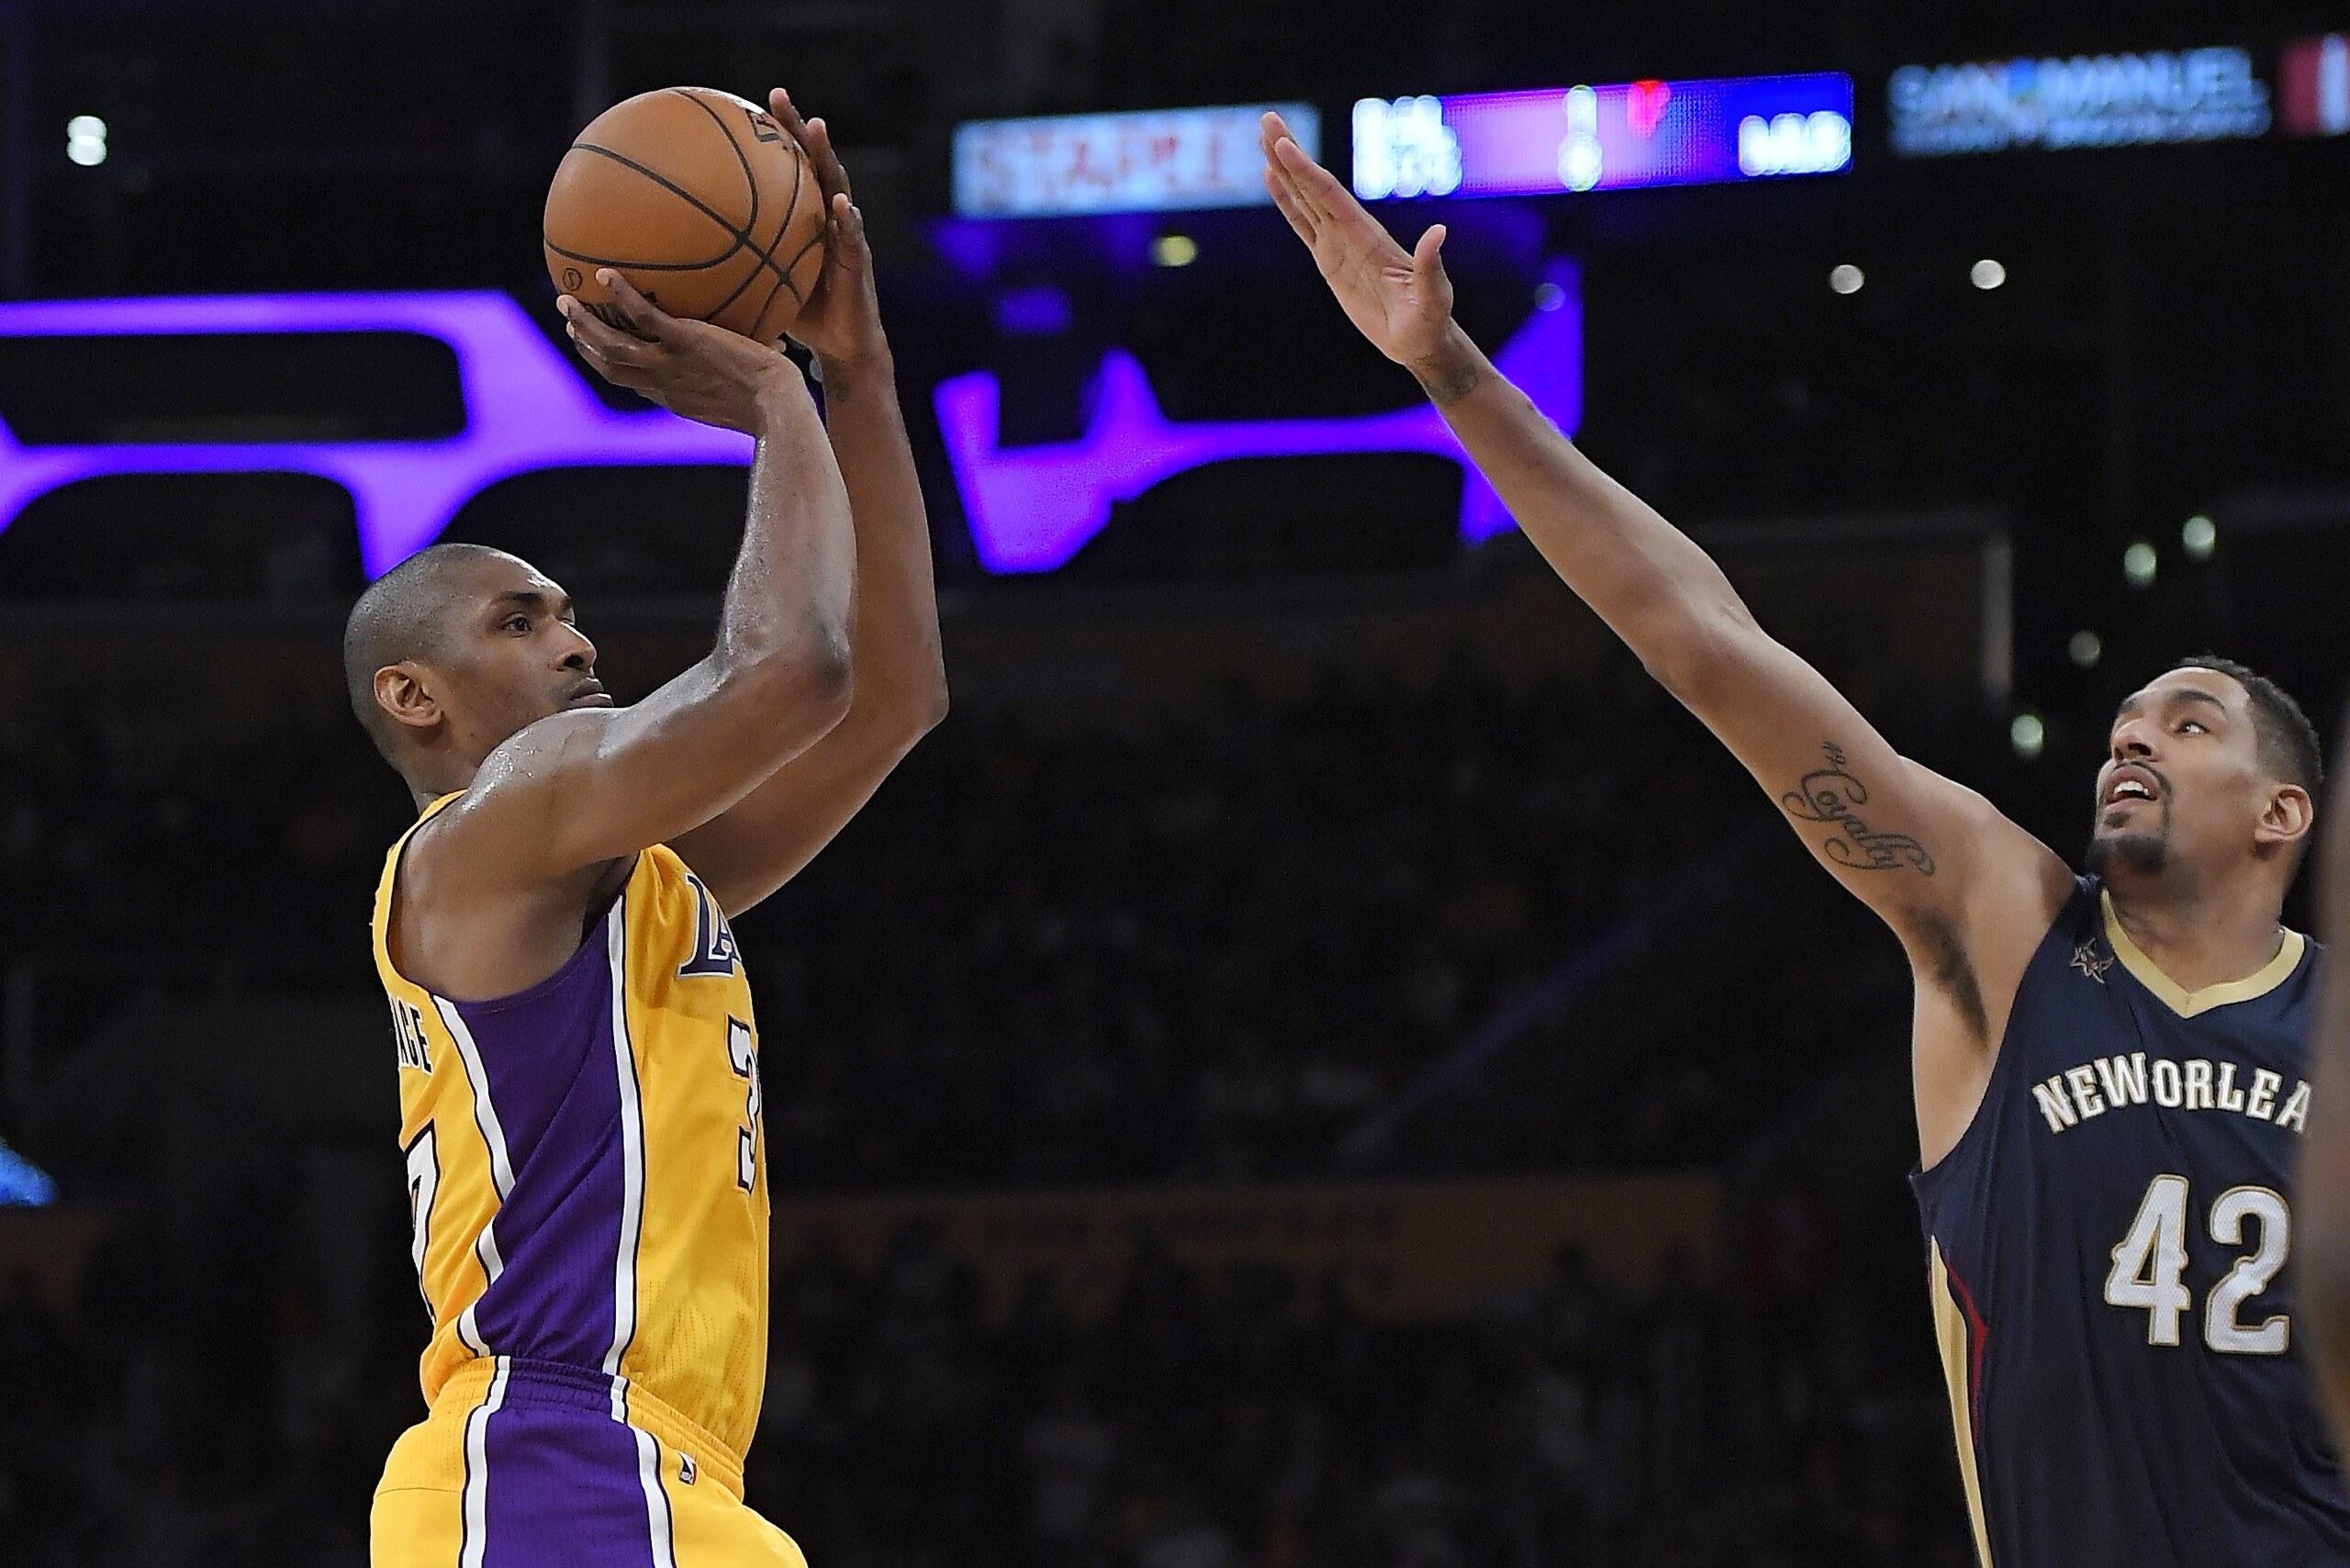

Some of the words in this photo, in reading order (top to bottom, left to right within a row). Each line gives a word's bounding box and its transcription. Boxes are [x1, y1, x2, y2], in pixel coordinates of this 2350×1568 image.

[966, 110, 1271, 207] STAPLE
[2032, 1052, 2149, 1135] NEW
[2104, 1174, 2291, 1355] 42
